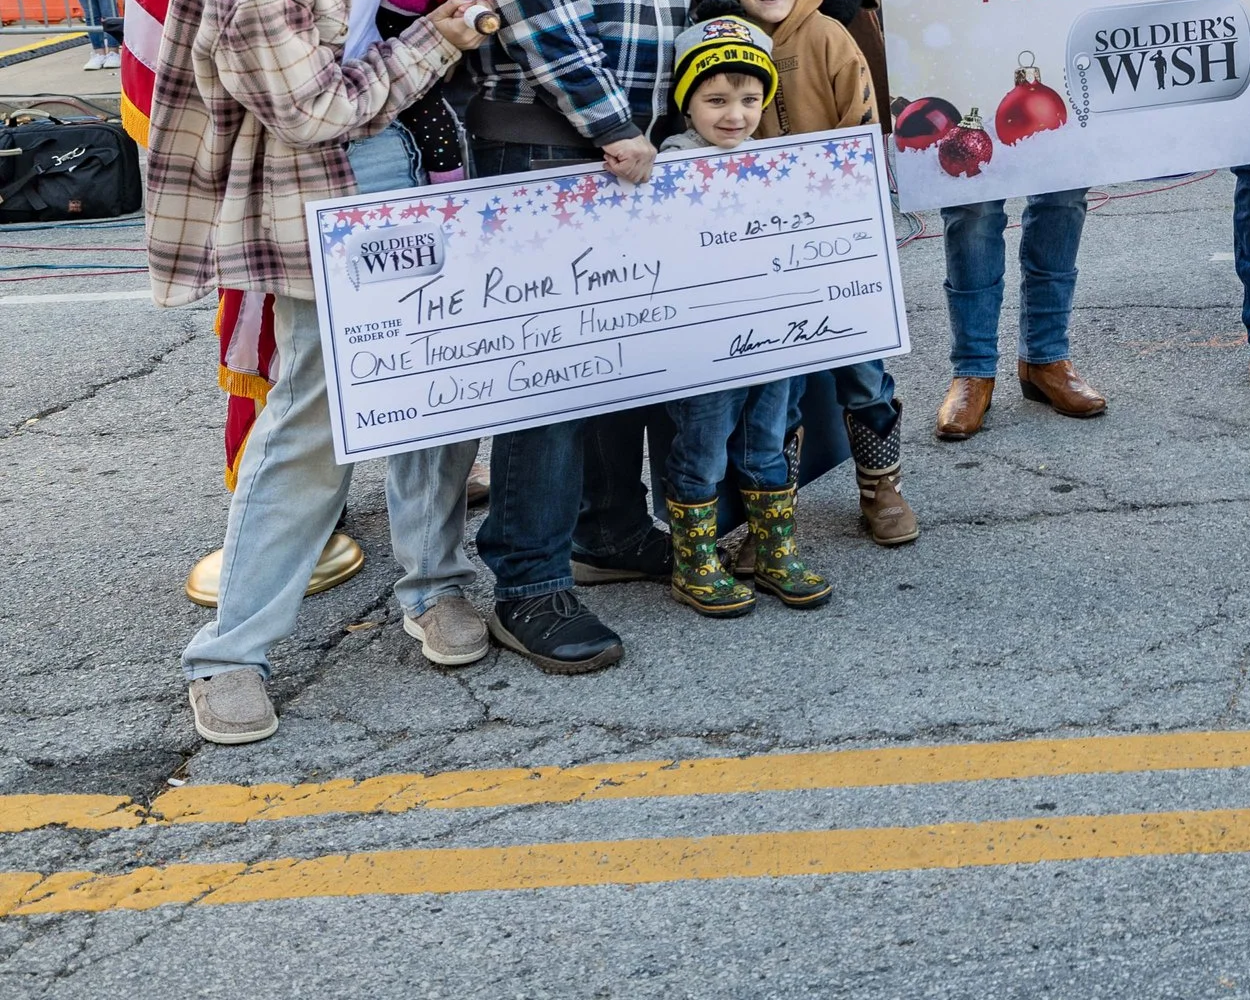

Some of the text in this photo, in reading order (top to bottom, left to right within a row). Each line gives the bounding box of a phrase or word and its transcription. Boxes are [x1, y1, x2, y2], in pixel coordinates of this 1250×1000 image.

[1094, 16, 1237, 52] SOLDIER'S
[695, 48, 766, 73] PUPS ON DUTY
[744, 211, 815, 236] 12-9-23
[360, 232, 435, 254] SOLDIER'S
[700, 231, 738, 248] Date
[828, 280, 883, 301] Dollars
[344, 319, 402, 336] PAY TO THE
[349, 329, 400, 344] ORDER OF
[356, 407, 418, 429] Memo
